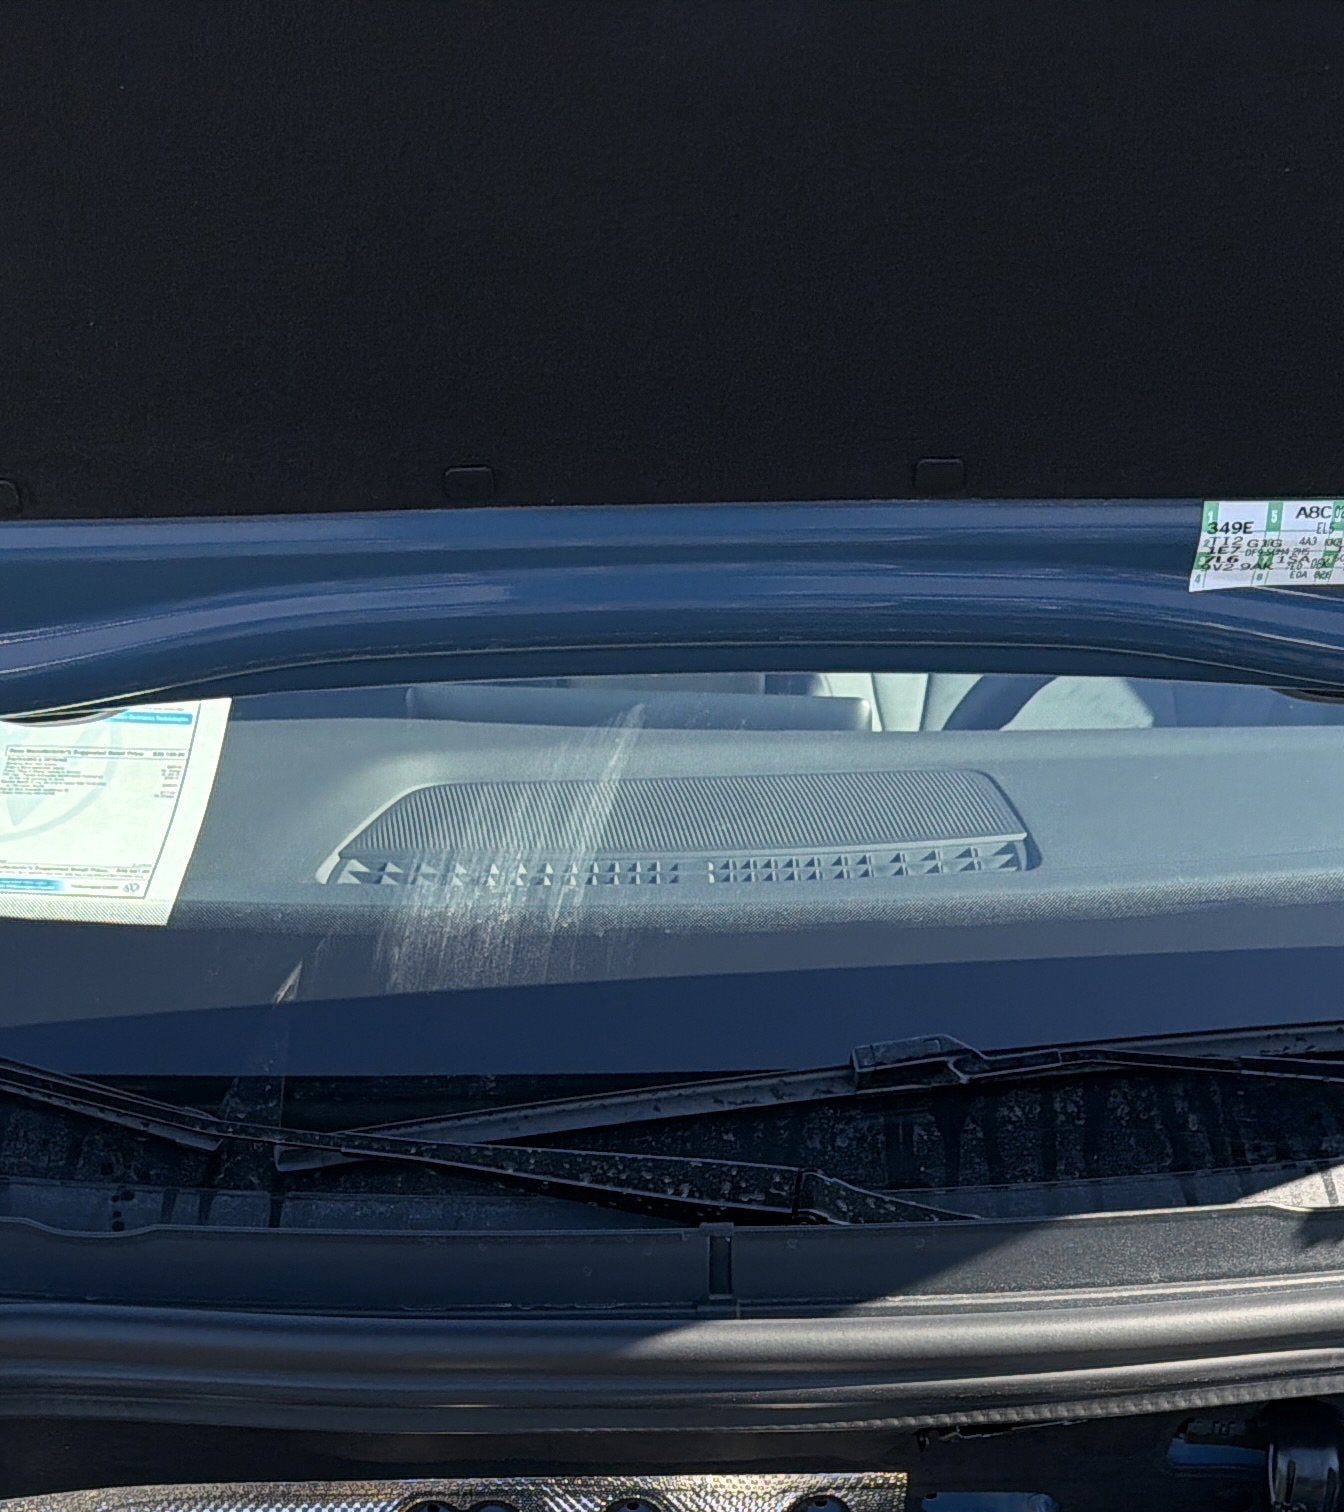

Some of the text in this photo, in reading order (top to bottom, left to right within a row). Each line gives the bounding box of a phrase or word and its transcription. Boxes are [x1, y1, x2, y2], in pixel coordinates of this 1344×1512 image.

[1207, 510, 1214, 522] 1
[1271, 510, 1278, 523] 5
[1207, 521, 1254, 534] 349E
